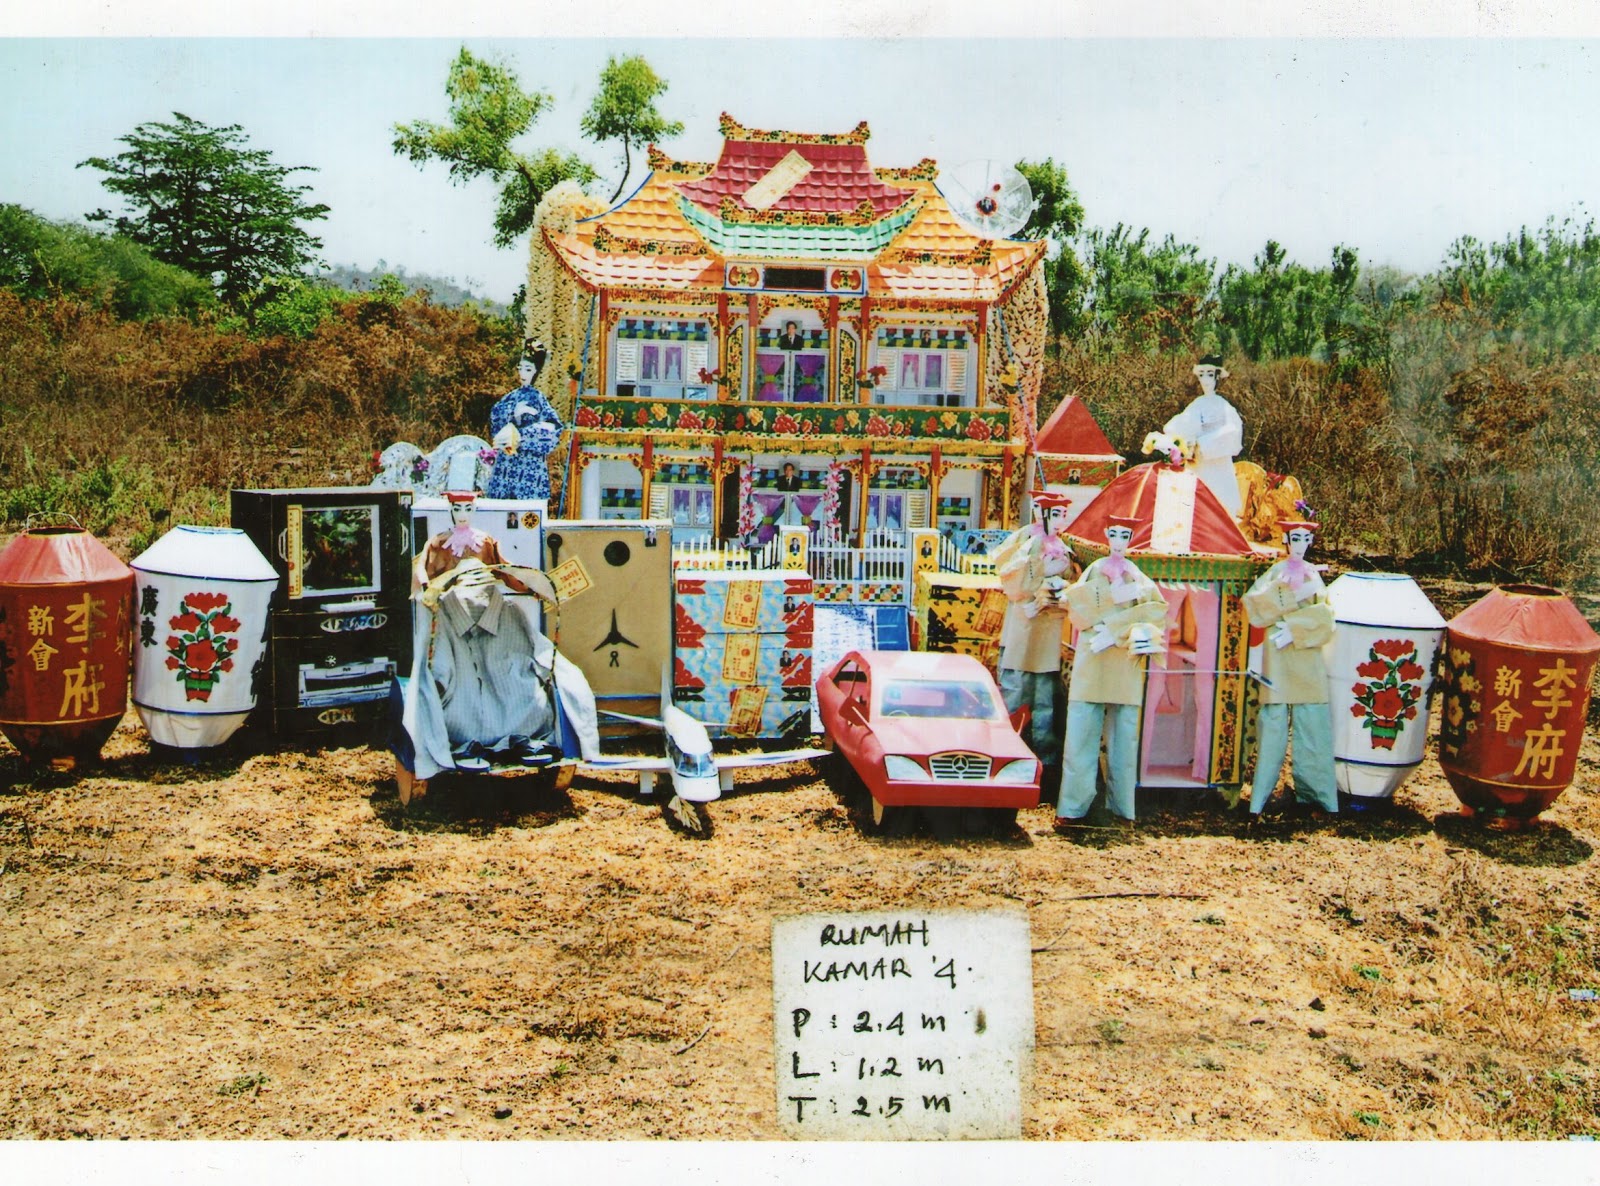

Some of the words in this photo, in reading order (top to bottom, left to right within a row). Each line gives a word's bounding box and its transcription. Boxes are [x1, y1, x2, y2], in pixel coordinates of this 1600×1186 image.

[26, 605, 59, 671] 新會
[140, 585, 159, 648] 廣東
[59, 592, 107, 717] 李府
[1490, 665, 1523, 733] 新會
[1513, 658, 1577, 780] 李府
[820, 920, 928, 947] RUMAH
[804, 957, 912, 983] KAMAR
[791, 1007, 811, 1037] P
[853, 1011, 904, 1036] 2.4
[921, 1013, 946, 1032] m
[792, 1051, 820, 1079] L
[858, 1057, 902, 1080] 1.2
[917, 1056, 944, 1075] m
[788, 1096, 817, 1123] T
[851, 1096, 905, 1118] 2.5
[922, 1095, 951, 1113] m
